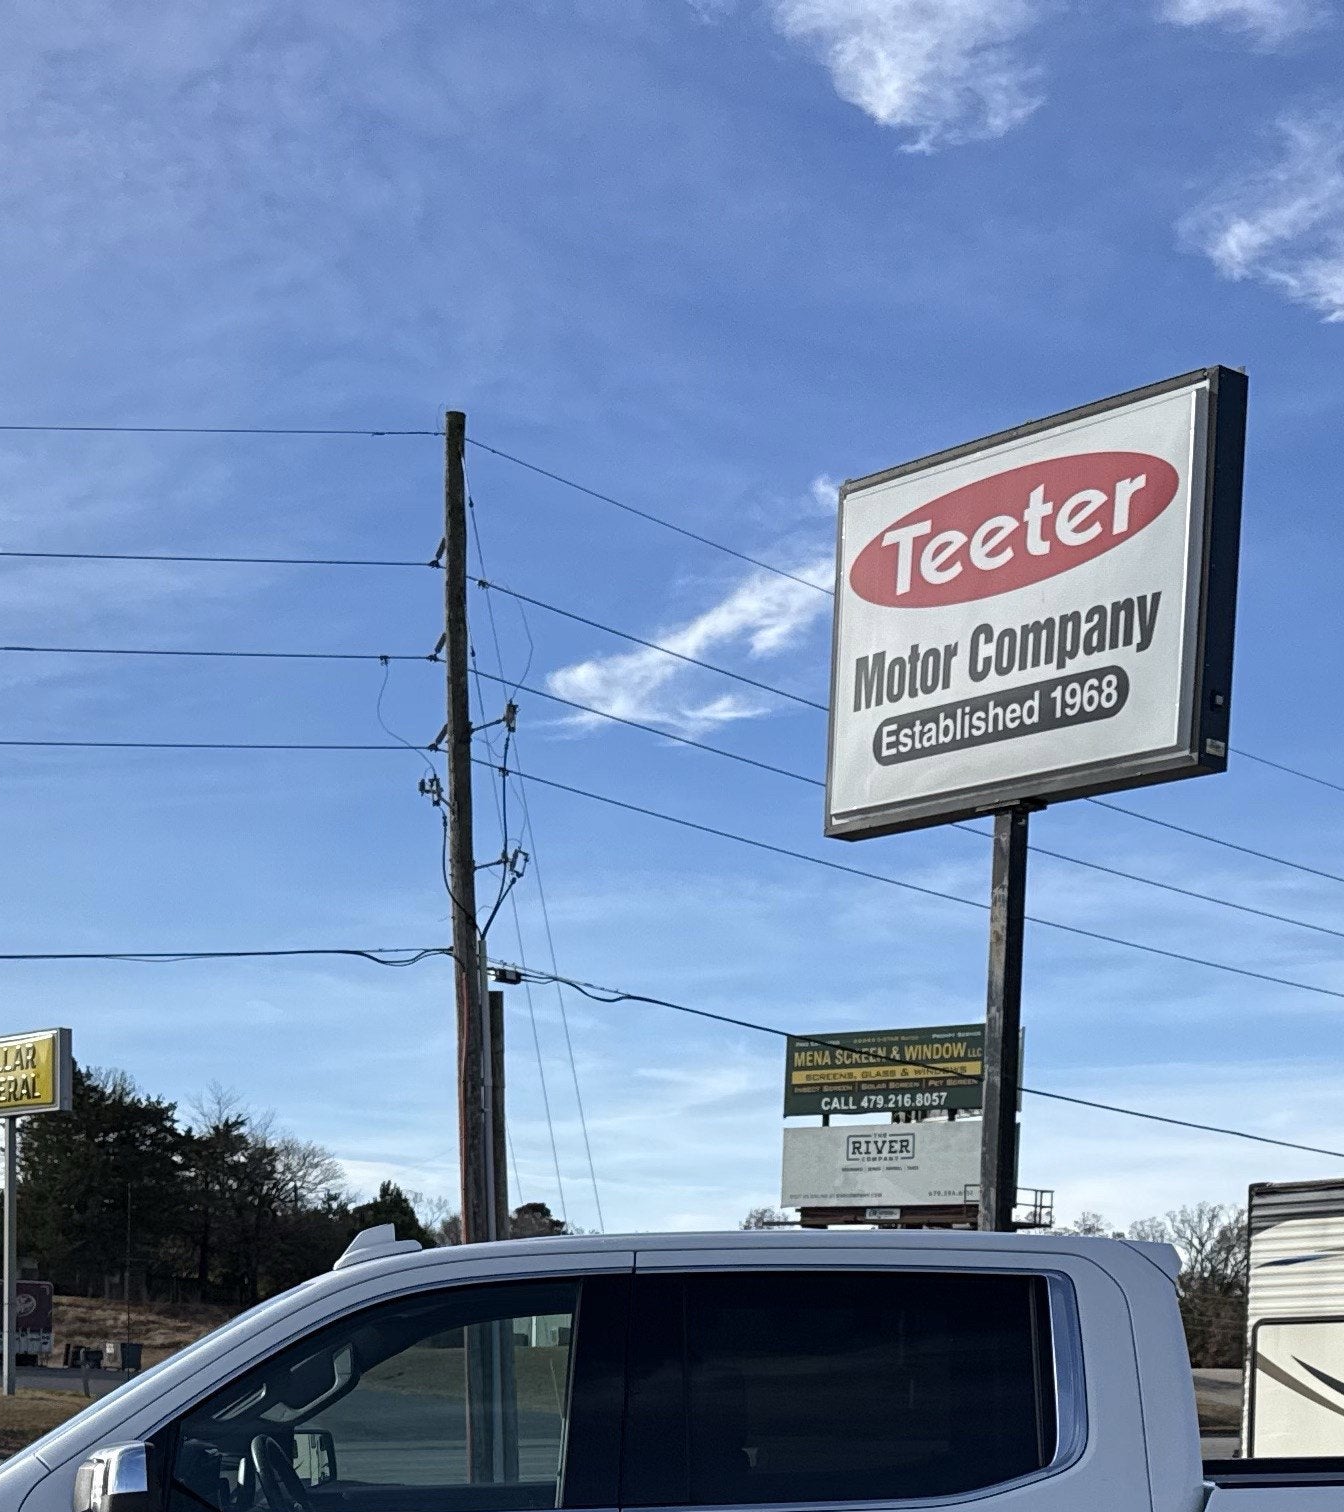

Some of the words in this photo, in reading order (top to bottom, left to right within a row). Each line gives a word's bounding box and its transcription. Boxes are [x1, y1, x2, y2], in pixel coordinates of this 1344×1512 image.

[881, 473, 1147, 597] Teeter
[852, 639, 959, 713] Motor
[968, 591, 1163, 685] Company
[879, 690, 1041, 757] Established
[1050, 673, 1119, 720] 1968
[793, 1050, 831, 1067] MENA
[835, 1046, 887, 1065] SCREEN
[890, 1046, 900, 1061] &
[904, 1042, 967, 1060] WINDOW
[967, 1047, 983, 1057] LLC
[861, 1069, 896, 1078] GLASS
[821, 1096, 857, 1110] CALL
[860, 1092, 947, 1109] 479.216.8057
[851, 1139, 911, 1155] RIVER
